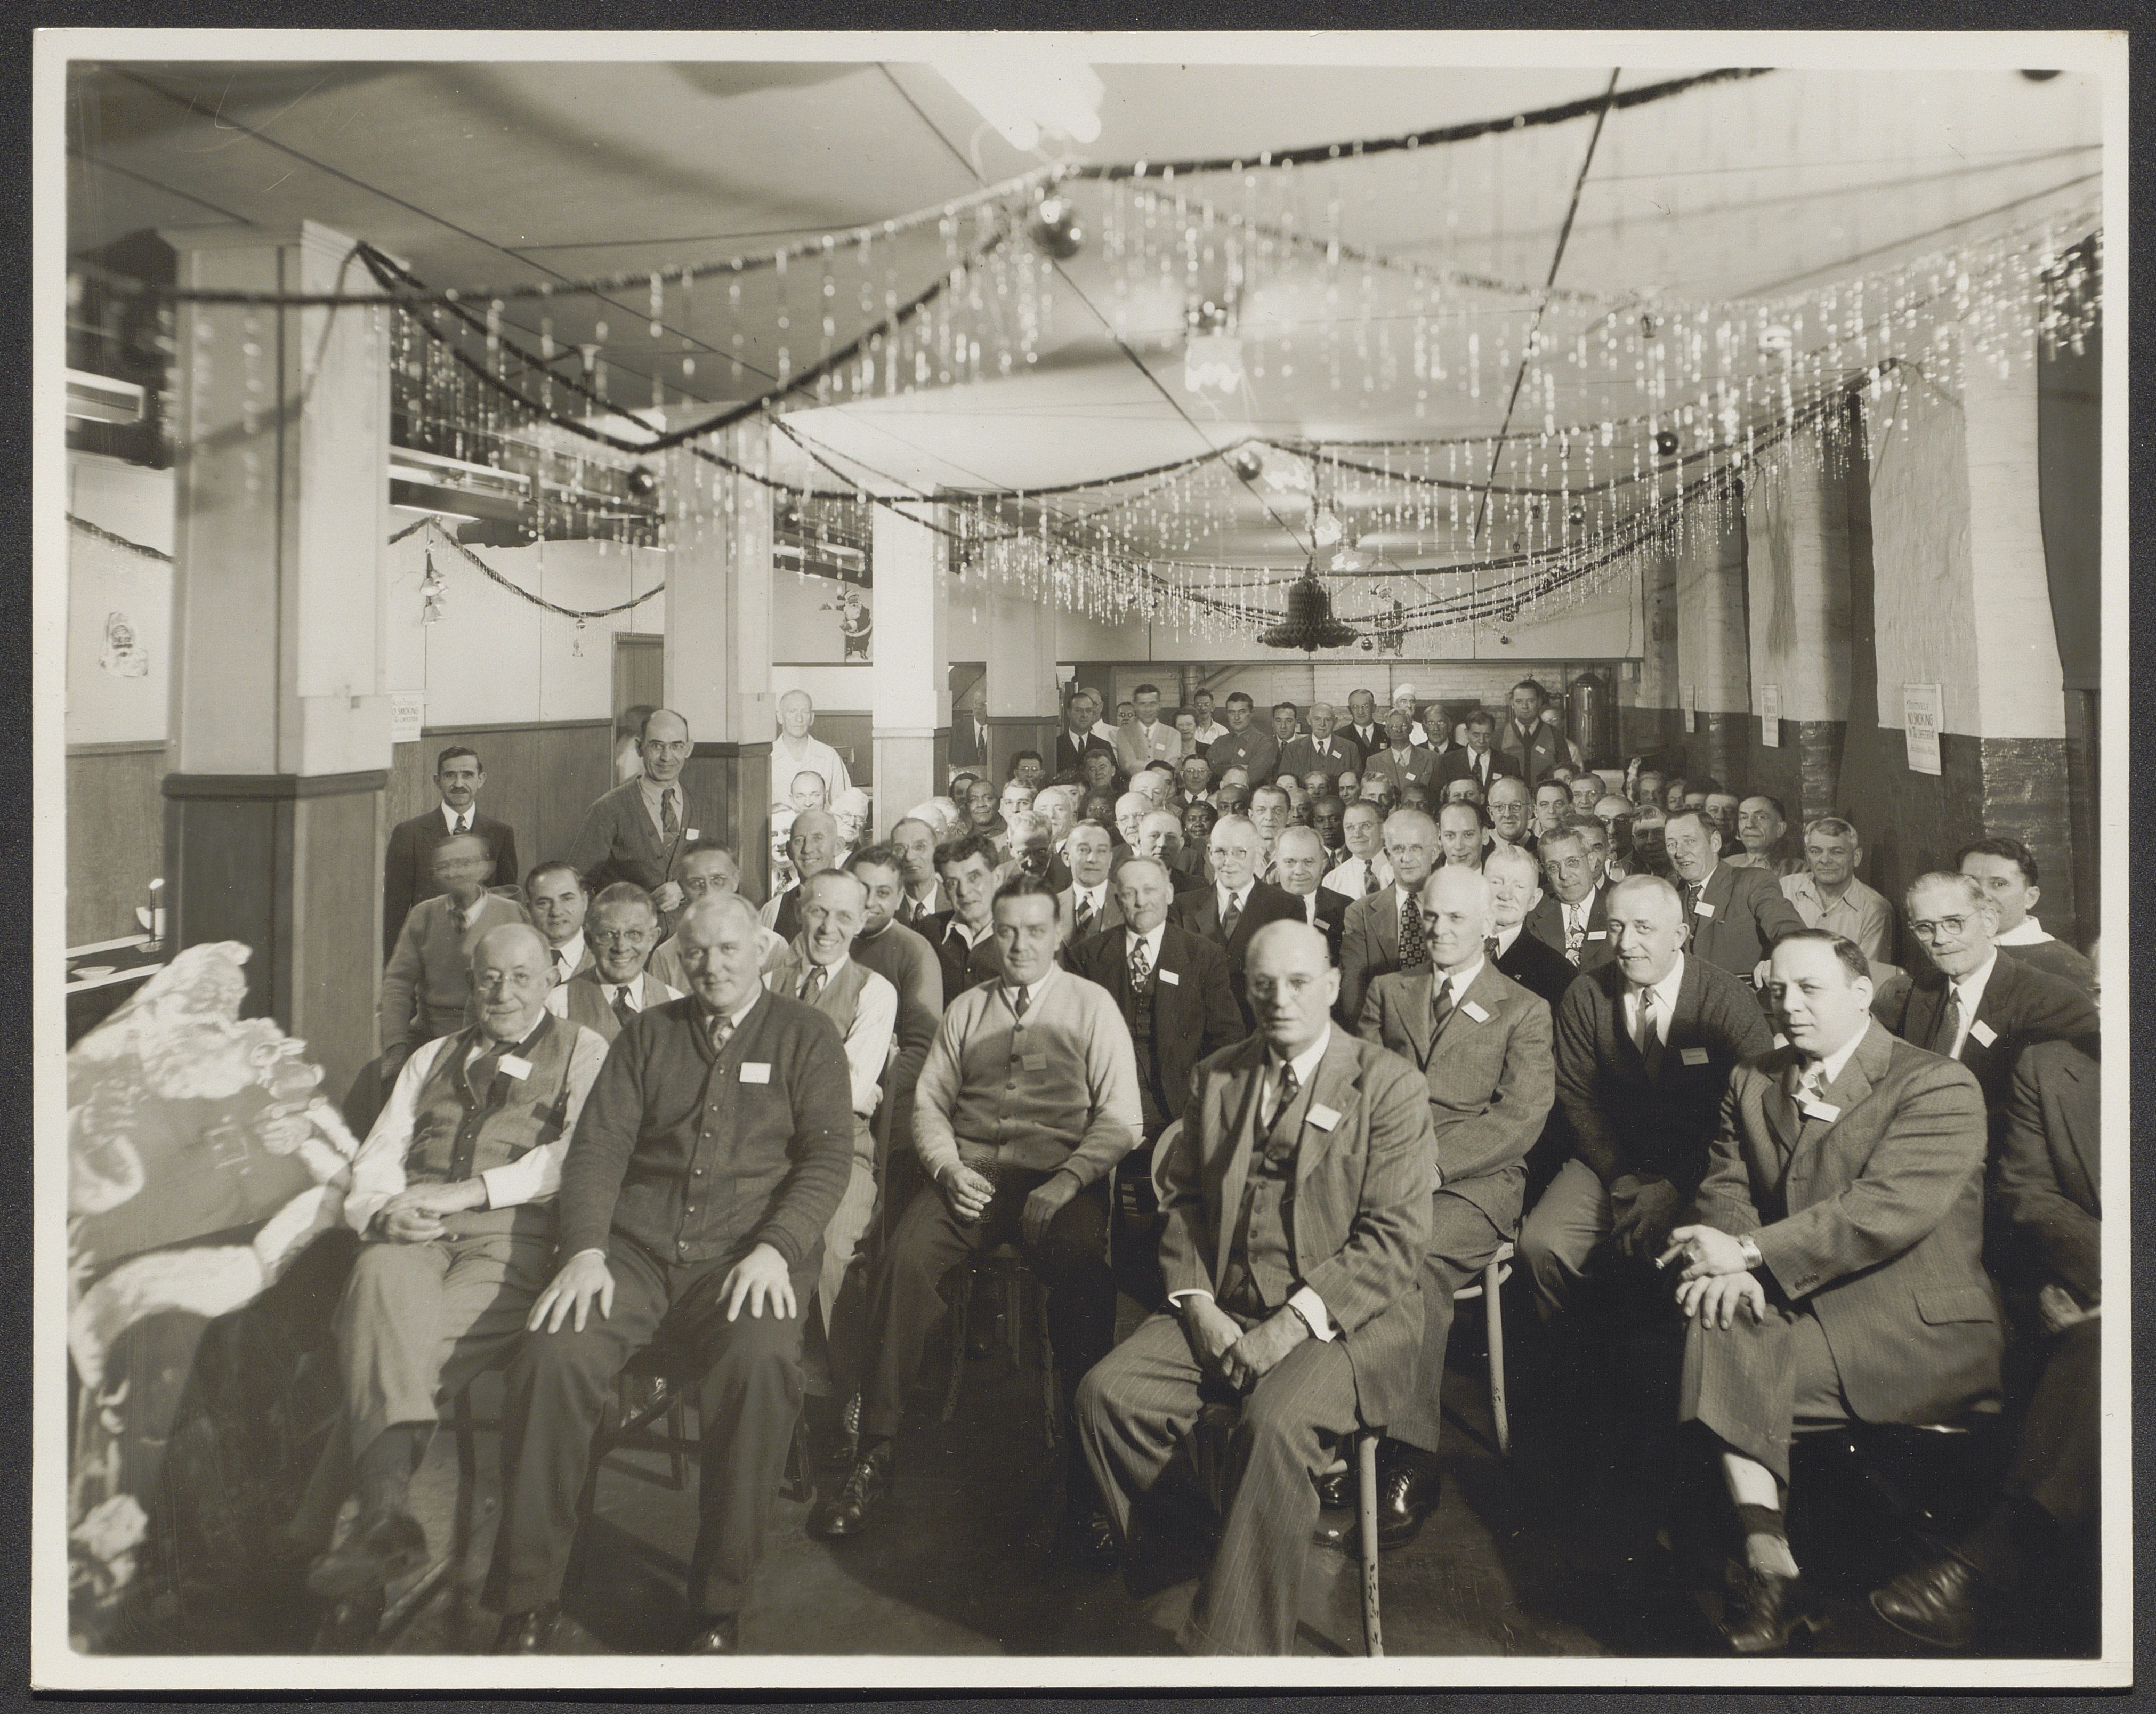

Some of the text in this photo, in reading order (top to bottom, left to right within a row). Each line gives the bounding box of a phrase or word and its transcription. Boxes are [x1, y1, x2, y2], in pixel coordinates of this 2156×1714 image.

[398, 707, 419, 715] SMOKING
[1908, 712, 1933, 726] NO SMOKING
